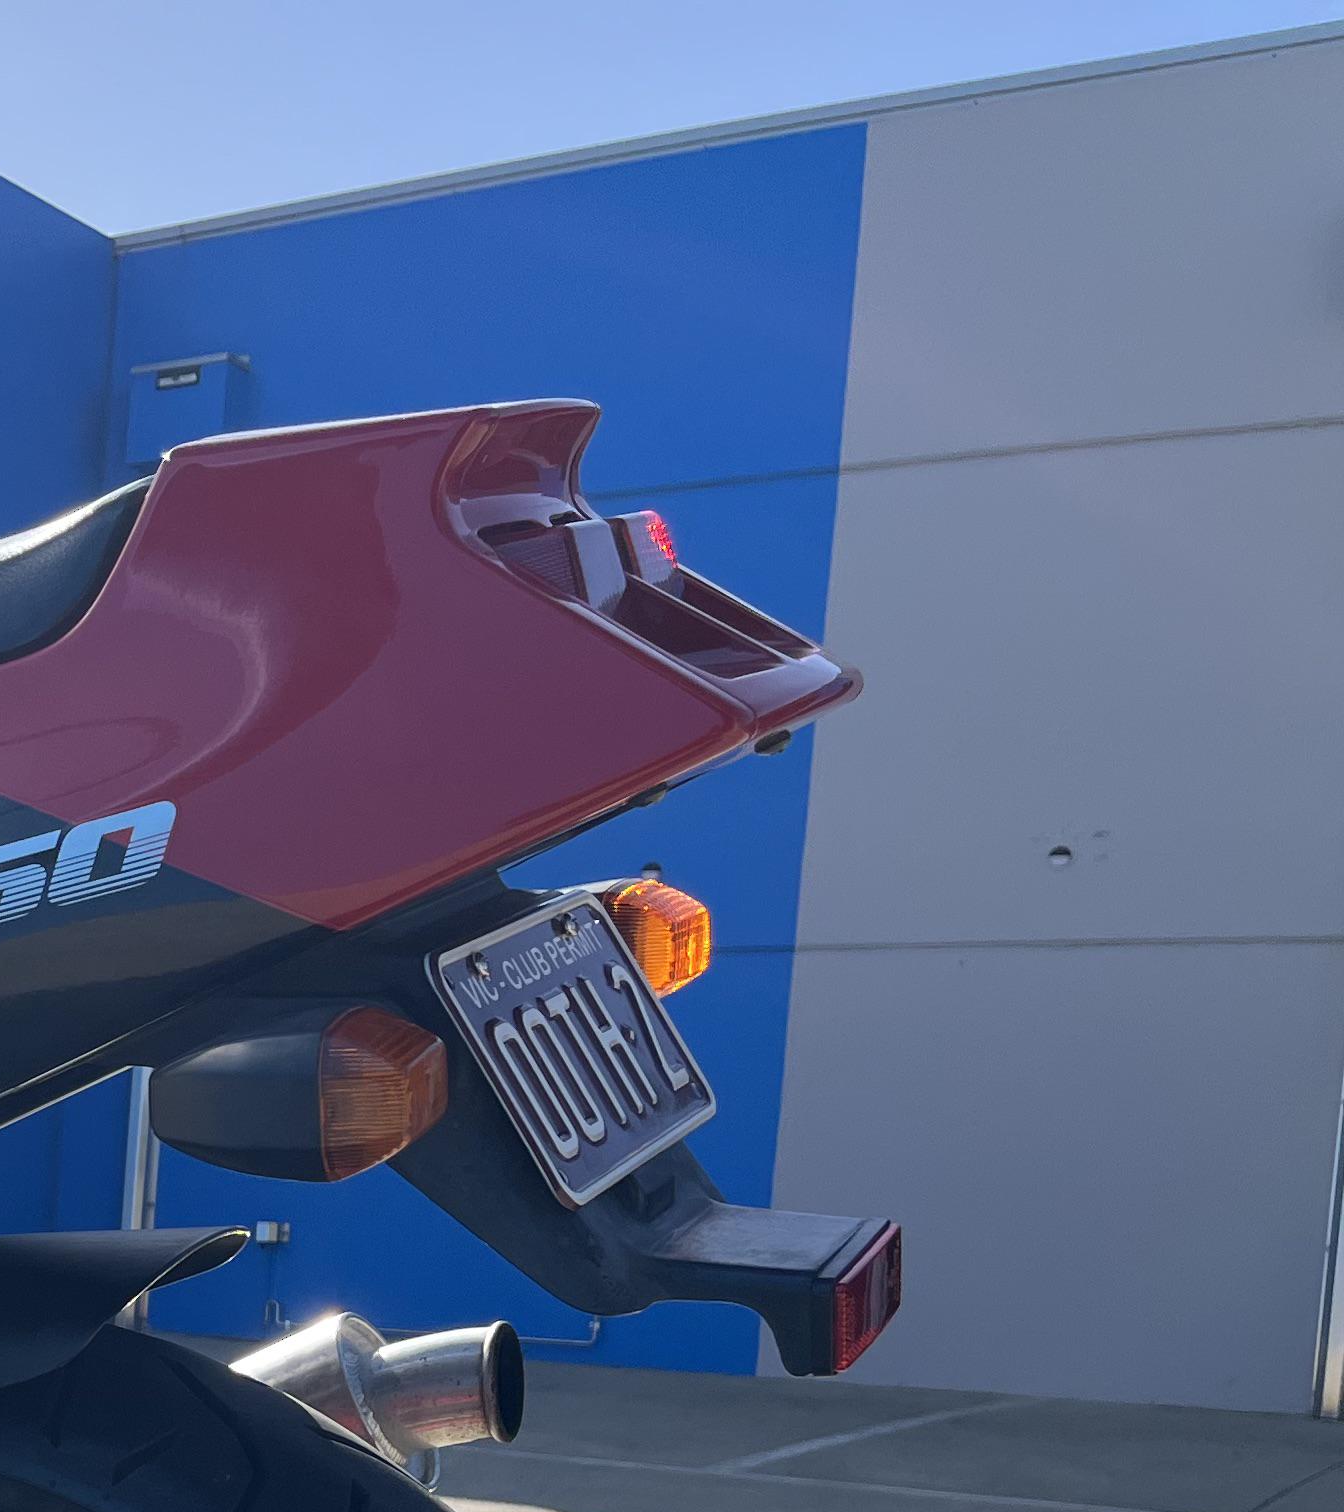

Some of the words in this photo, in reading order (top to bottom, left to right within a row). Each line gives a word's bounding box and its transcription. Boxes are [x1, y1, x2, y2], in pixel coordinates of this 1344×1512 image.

[460, 970, 499, 1009] VIC
[502, 941, 552, 990] CLUB
[549, 925, 603, 970] PERMIT
